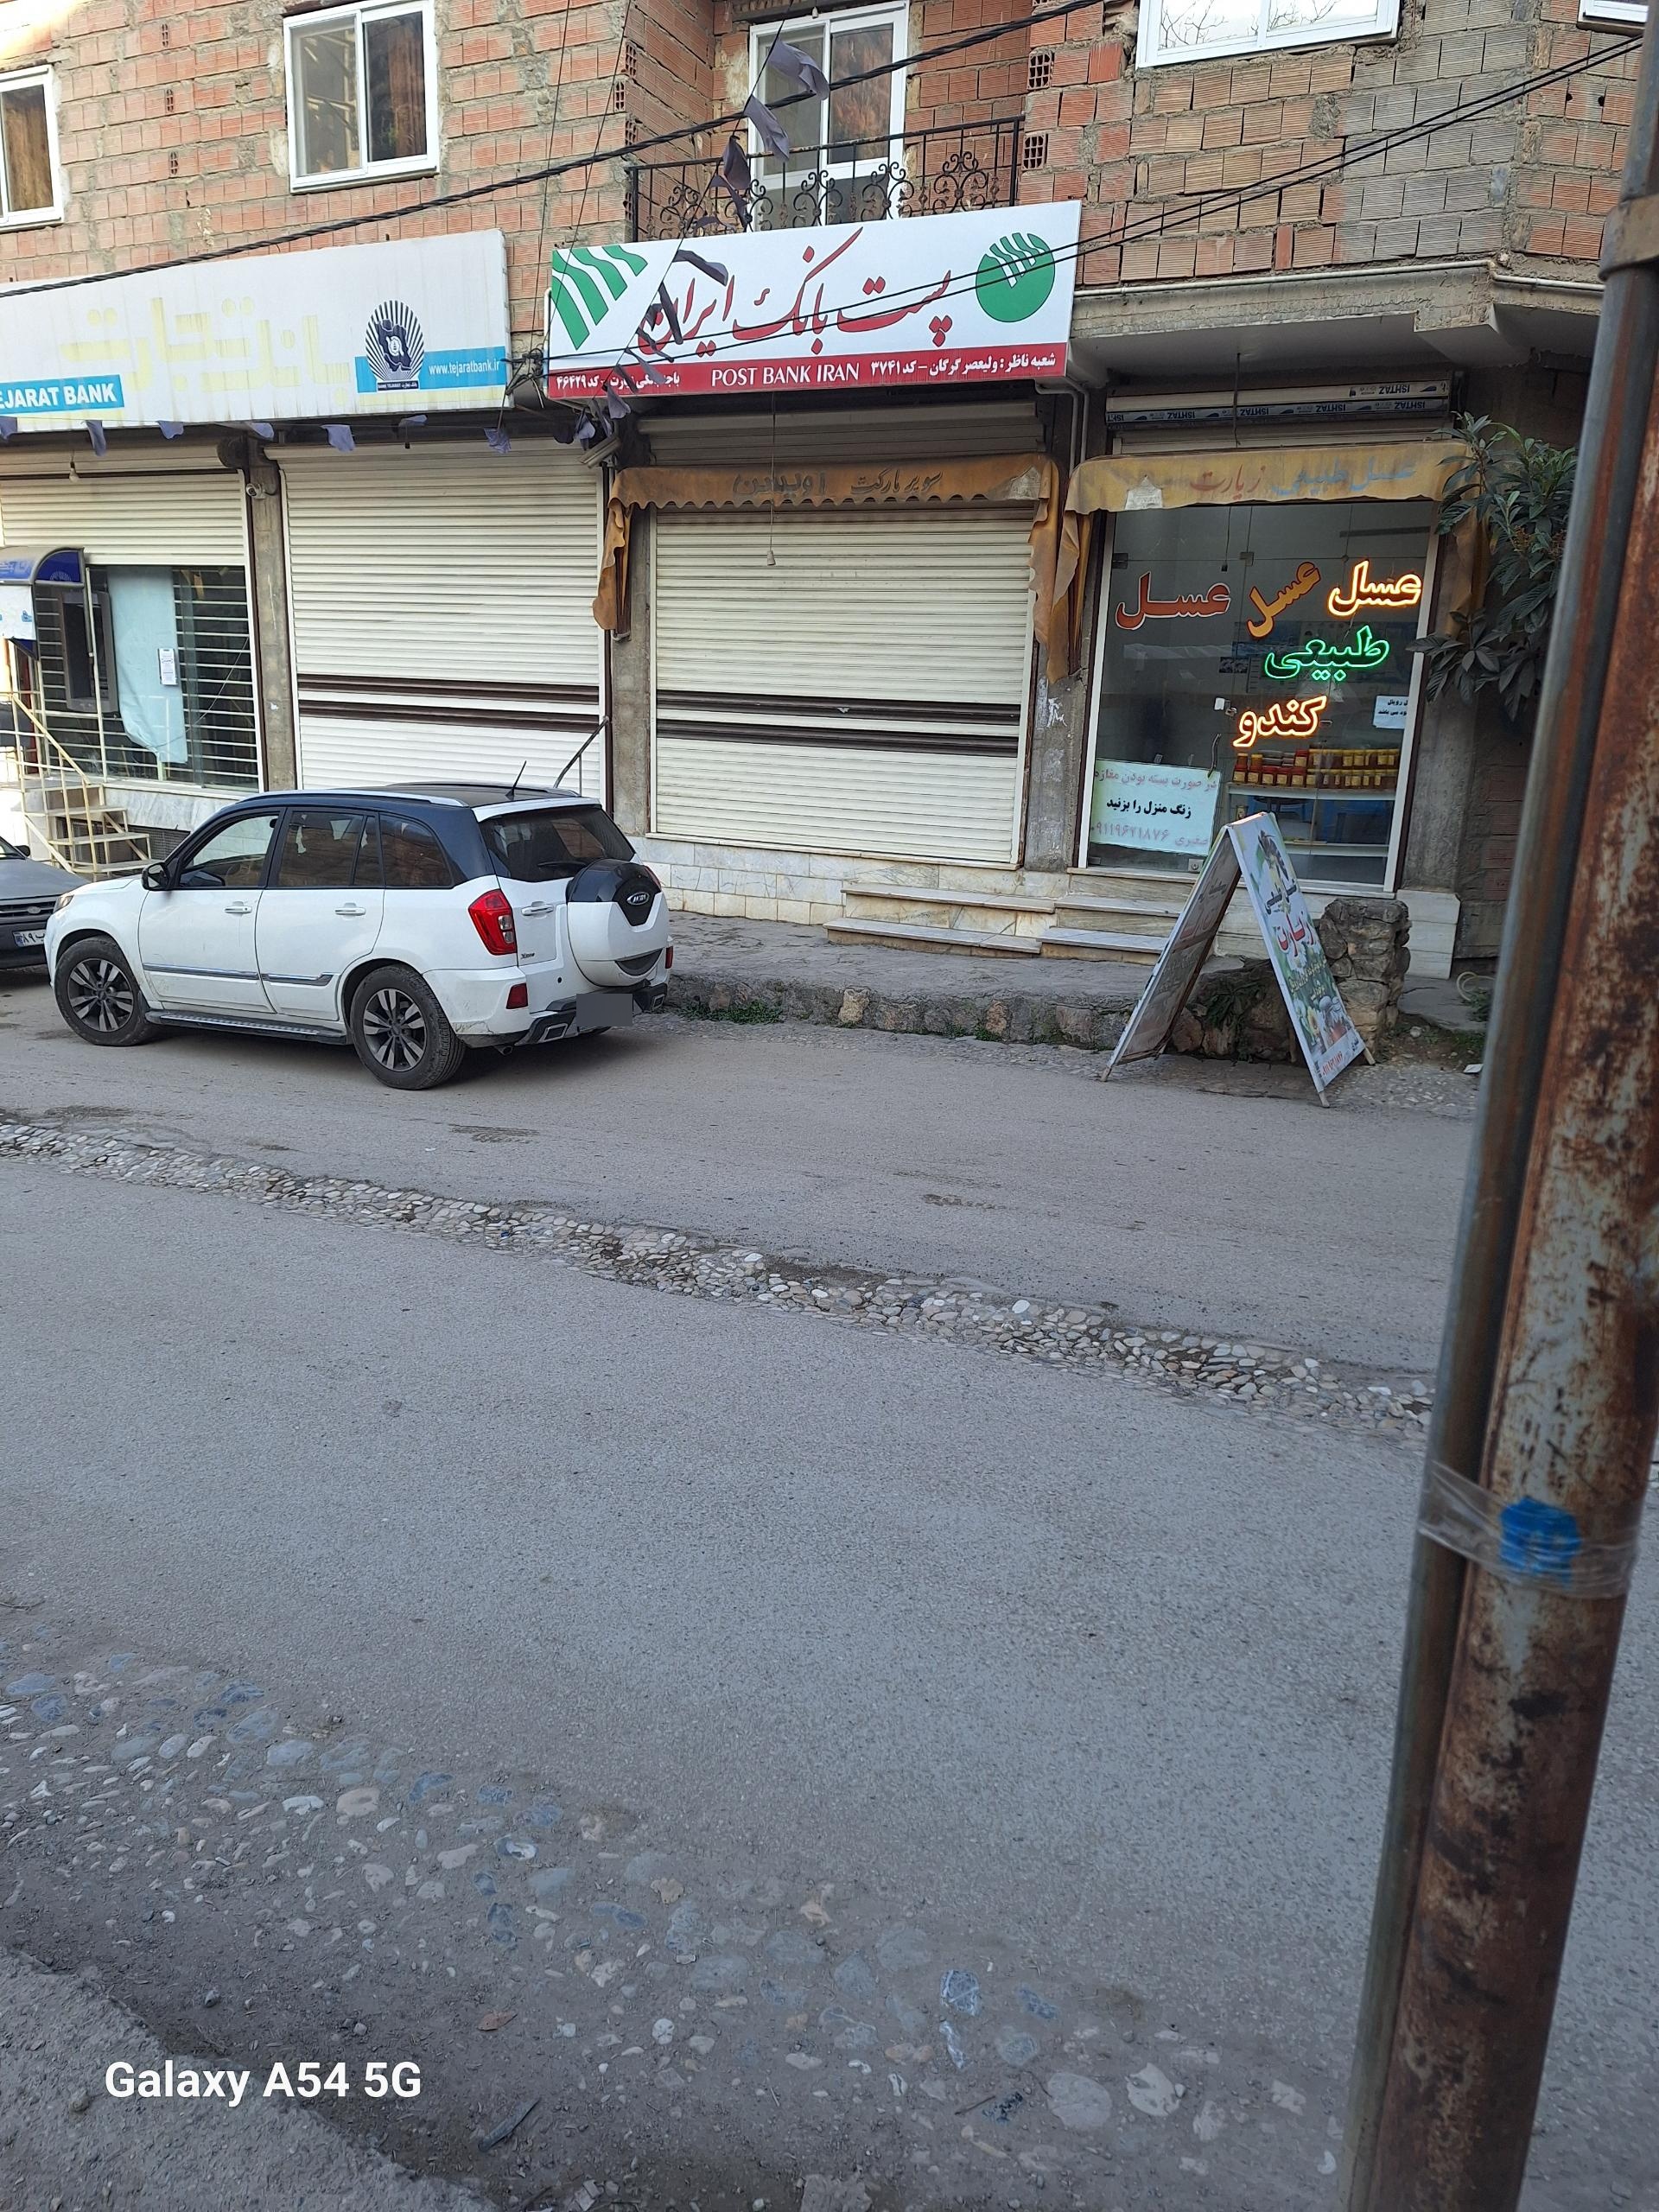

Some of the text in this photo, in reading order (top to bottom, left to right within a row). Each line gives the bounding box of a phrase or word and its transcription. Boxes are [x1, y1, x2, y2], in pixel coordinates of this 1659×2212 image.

[638, 226, 952, 356] پست بانک ایران
[59, 295, 351, 408] بانک تجارت
[429, 359, 499, 377] www.tejaratbank.ir
[870, 360, 900, 377] ۳۷۴۱
[902, 359, 917, 373] کد
[929, 357, 962, 376] گرگان
[962, 355, 998, 374] ولیعصر
[1031, 353, 1056, 371] شعبه
[588, 375, 601, 387] کد
[609, 375, 635, 390] زارت
[662, 372, 680, 387] باج
[711, 363, 860, 386] POST BANK IRAN
[63, 383, 118, 405] BANK
[1190, 463, 1266, 500] زیارت
[1328, 559, 1422, 616] عسل
[1115, 571, 1231, 630] عسل
[1247, 562, 1321, 637] عسل
[1264, 625, 1390, 681] طبیعی
[1232, 695, 1327, 747] کندو
[1094, 768, 1119, 782] مغازه
[1122, 773, 1145, 785] بودن
[1172, 778, 1202, 790] صورت
[1204, 781, 1217, 791] در
[1107, 797, 1192, 819] زنگ منزل را بزنید
